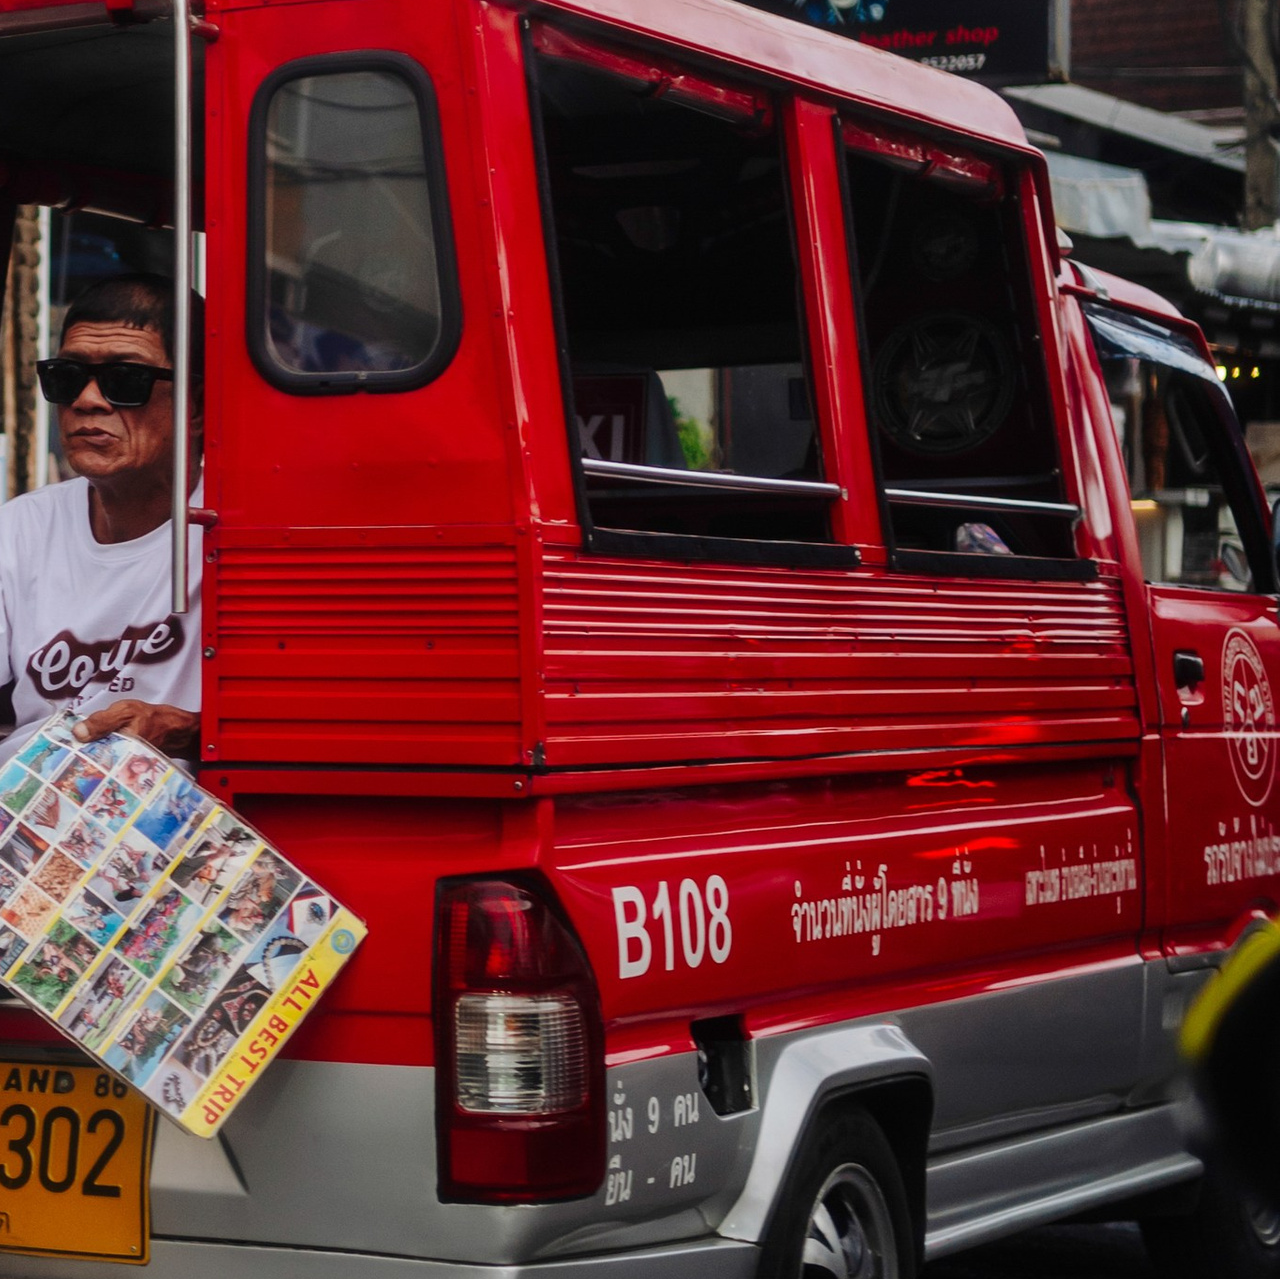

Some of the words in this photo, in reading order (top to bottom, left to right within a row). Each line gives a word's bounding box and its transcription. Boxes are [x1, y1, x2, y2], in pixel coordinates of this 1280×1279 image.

[945, 24, 1000, 48] shop
[937, 876, 948, 920] 9
[611, 874, 733, 980] B108
[281, 968, 320, 1012] ALL
[240, 1014, 290, 1074] BEST
[202, 1073, 246, 1125] TRIP
[647, 1096, 660, 1134] 9
[673, 1092, 699, 1127] คน
[669, 1153, 696, 1189] คน
